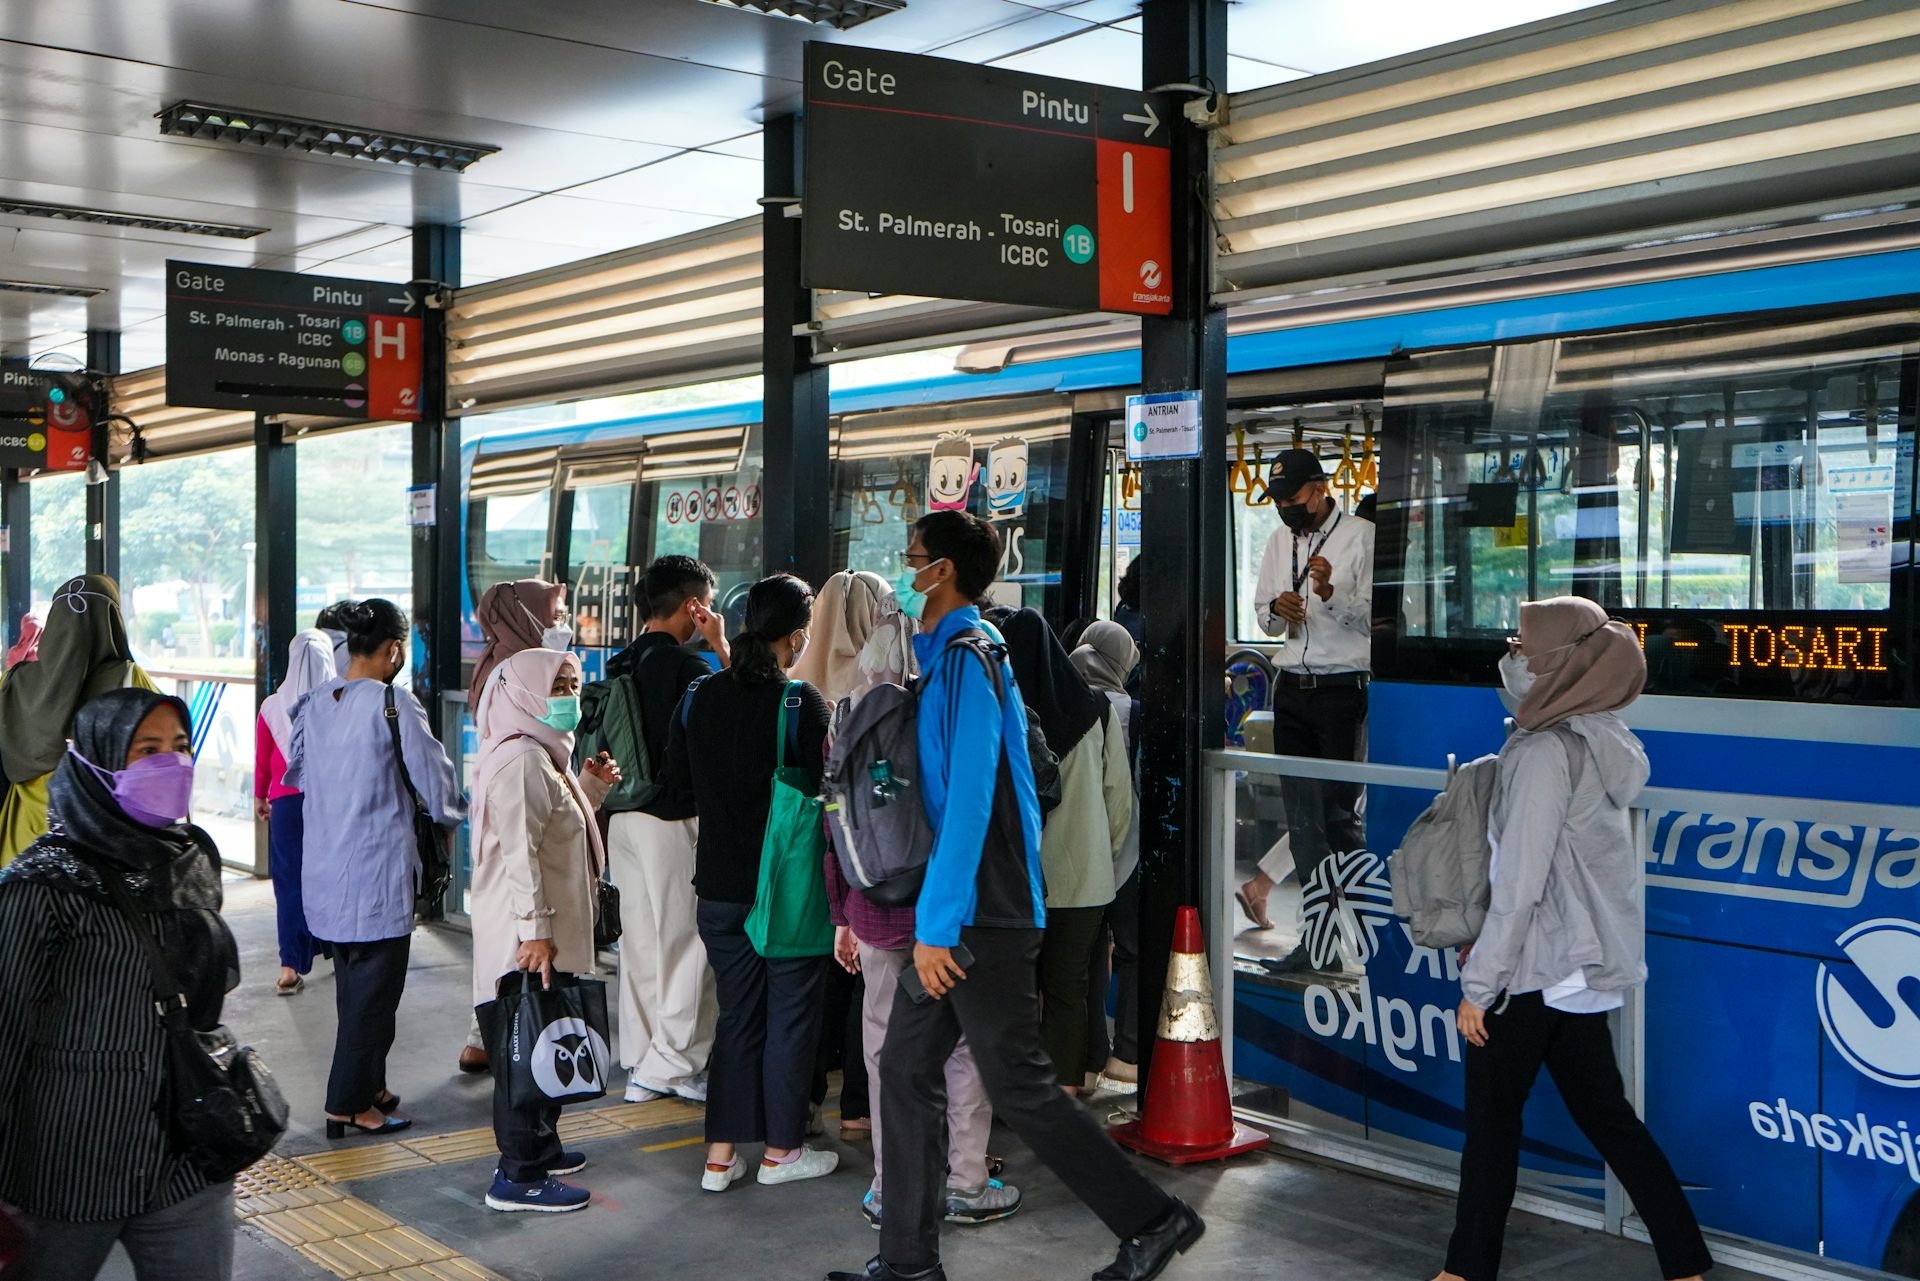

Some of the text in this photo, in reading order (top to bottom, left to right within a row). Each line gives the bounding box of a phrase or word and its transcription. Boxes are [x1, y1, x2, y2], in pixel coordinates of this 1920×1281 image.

[823, 60, 897, 97] Gate
[1022, 89, 1090, 125] Pintu
[838, 208, 870, 233] St.
[878, 211, 982, 242] Palmerah
[1000, 213, 1060, 239] Tosari
[1000, 243, 1049, 267] ICBC
[1066, 233, 1091, 255] 1B
[175, 270, 225, 292] Gate
[313, 286, 363, 306] Pintu
[189, 311, 211, 325] St.
[216, 313, 284, 331] Palmerah
[297, 313, 340, 330] Tosari
[344, 325, 363, 339] 1B
[297, 331, 332, 347] ICBC
[374, 319, 405, 361] H
[215, 347, 265, 364] Monas
[278, 351, 340, 370] Ragunan
[1147, 404, 1179, 417] ANTRIAN
[1723, 624, 1888, 671] TOSARI
[512, 1034, 520, 1054] MAXX
